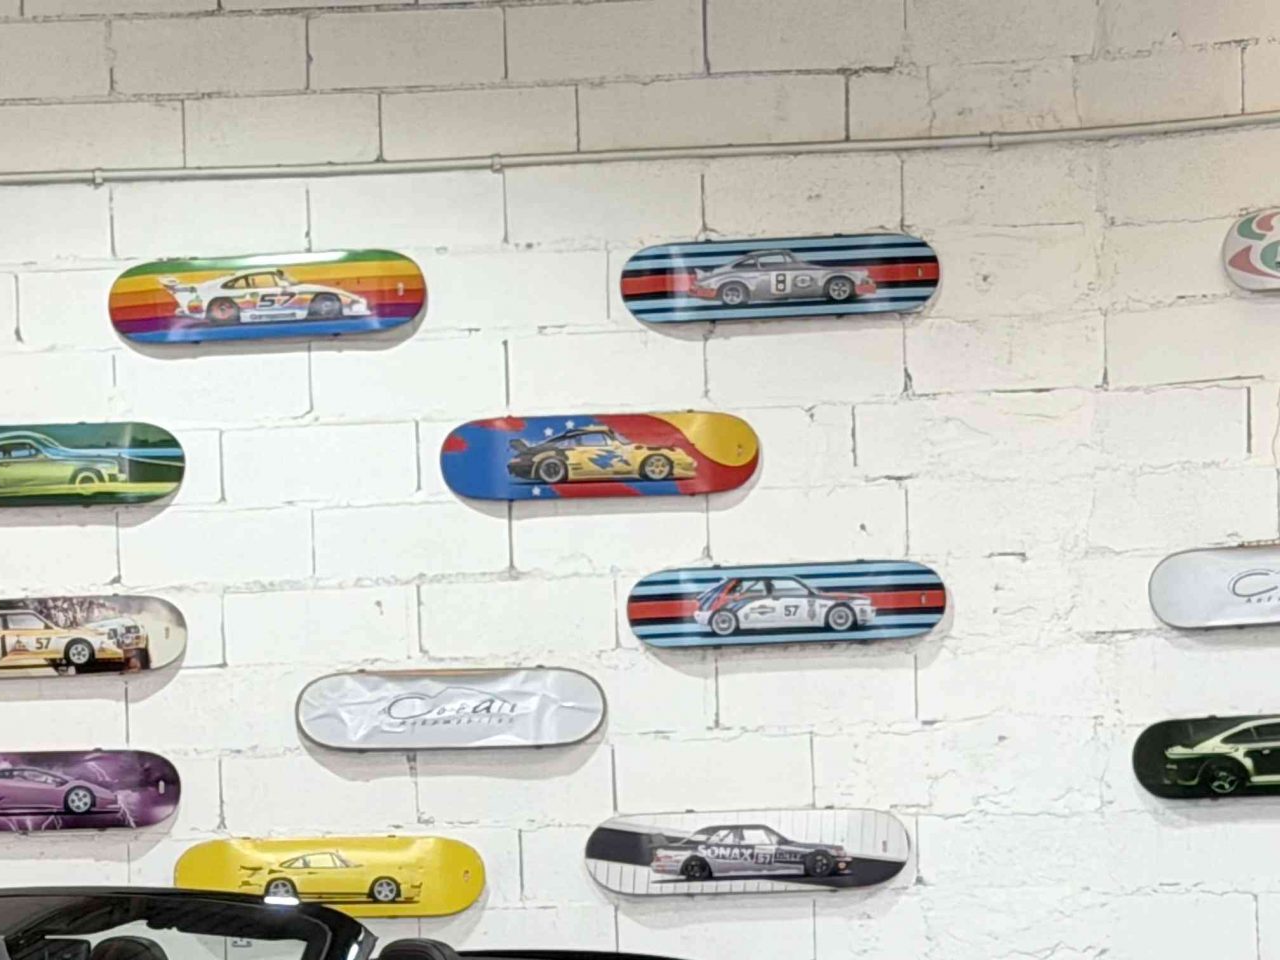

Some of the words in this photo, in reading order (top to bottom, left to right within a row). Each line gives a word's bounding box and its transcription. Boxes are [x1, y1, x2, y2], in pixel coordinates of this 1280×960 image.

[260, 292, 296, 308] 57
[784, 605, 799, 617] 57
[35, 637, 51, 650] 57
[698, 844, 753, 862] SONAX
